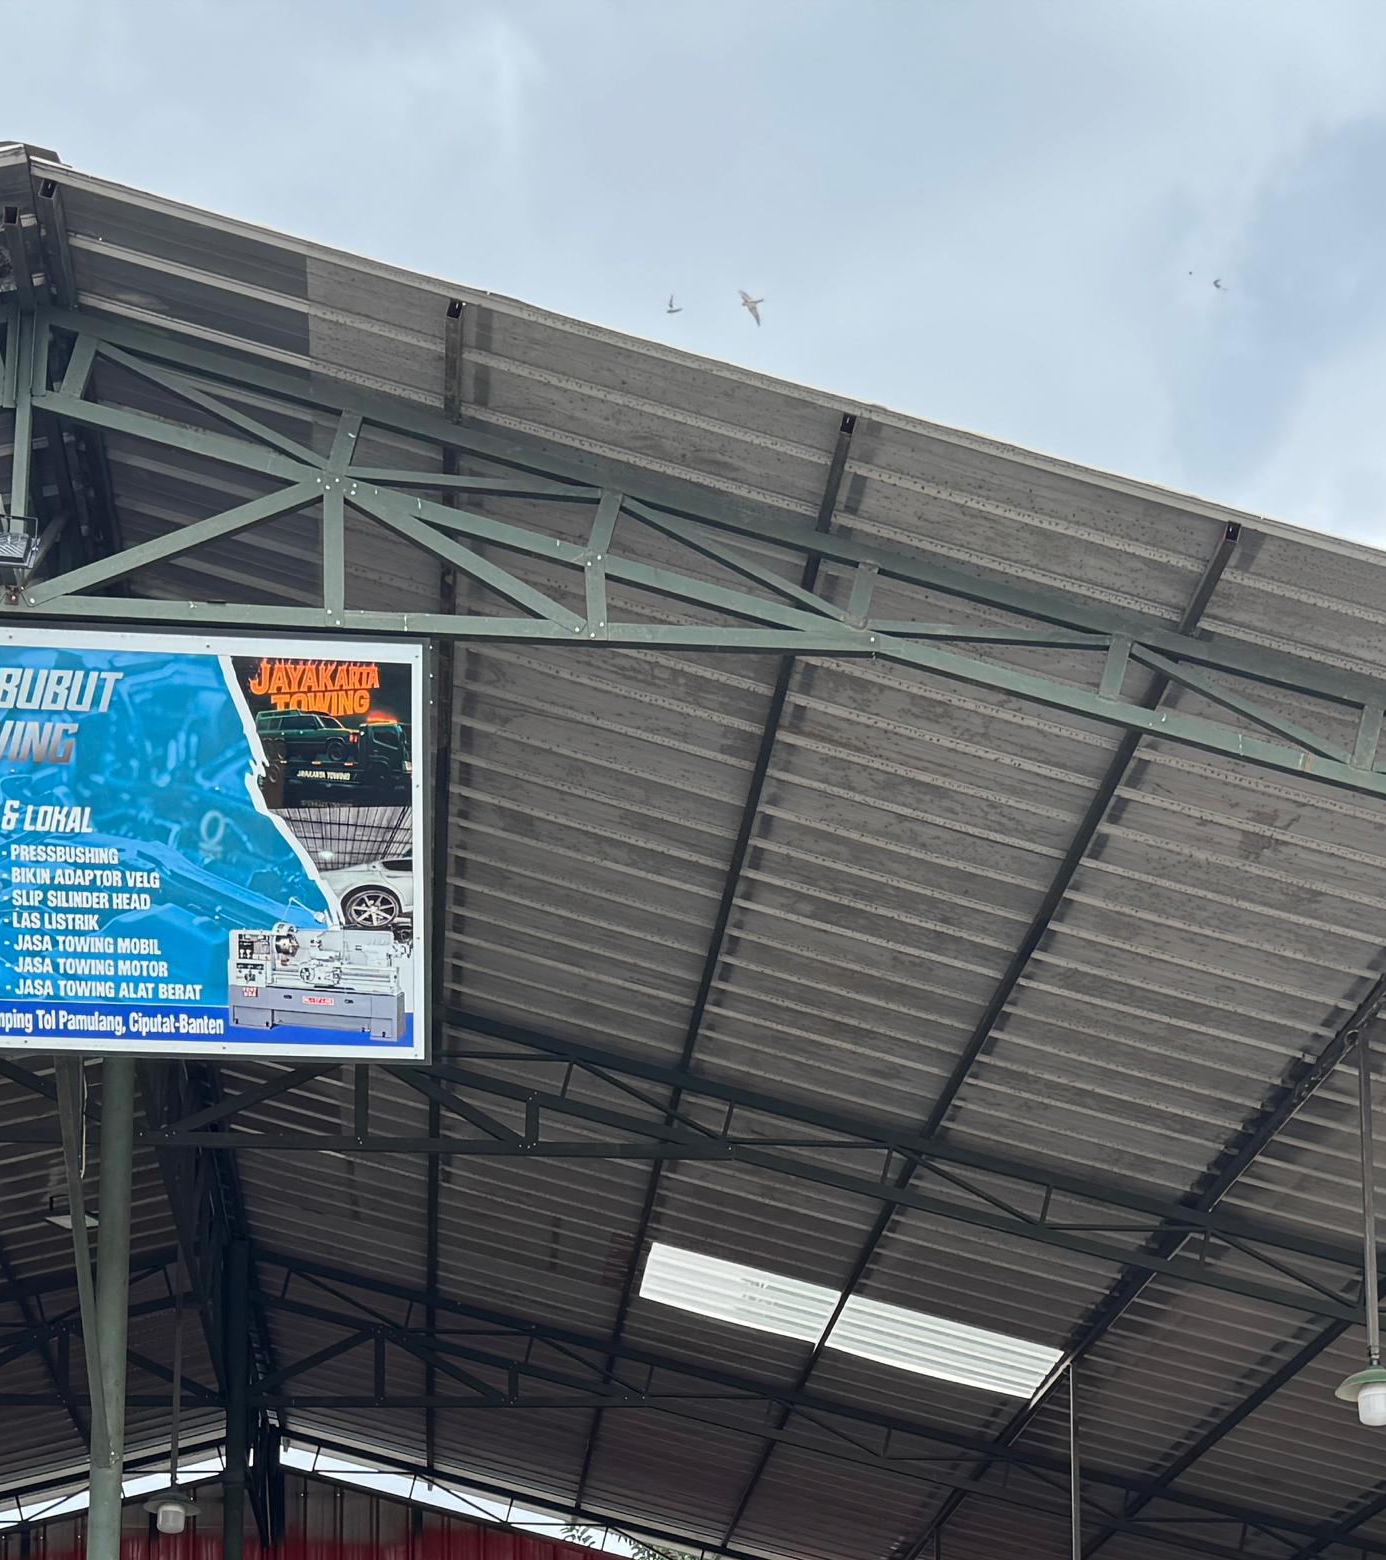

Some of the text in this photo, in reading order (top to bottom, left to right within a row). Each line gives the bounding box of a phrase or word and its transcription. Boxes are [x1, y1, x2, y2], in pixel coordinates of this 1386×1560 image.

[249, 660, 380, 695] JAYAKARTA
[271, 690, 370, 716] TOWING
[1, 800, 20, 831] &
[23, 805, 93, 833] LOKAL
[10, 844, 118, 864] PRESSBUSHING
[11, 867, 160, 888] BIKIN ADAPTOR VELG
[12, 890, 150, 910] SLIP SILINDER HEAD
[13, 912, 100, 930] LAS LISTRIK
[14, 935, 161, 955] JASA TOWING MOBIL
[14, 957, 168, 977] JASA TOWING MOTOR
[15, 979, 202, 1000] JASA TOWING ALAT BERAT
[35, 1009, 56, 1030] Tol
[59, 1010, 126, 1036] Pamulang,
[129, 1012, 224, 1036] Ciputat-Banten
